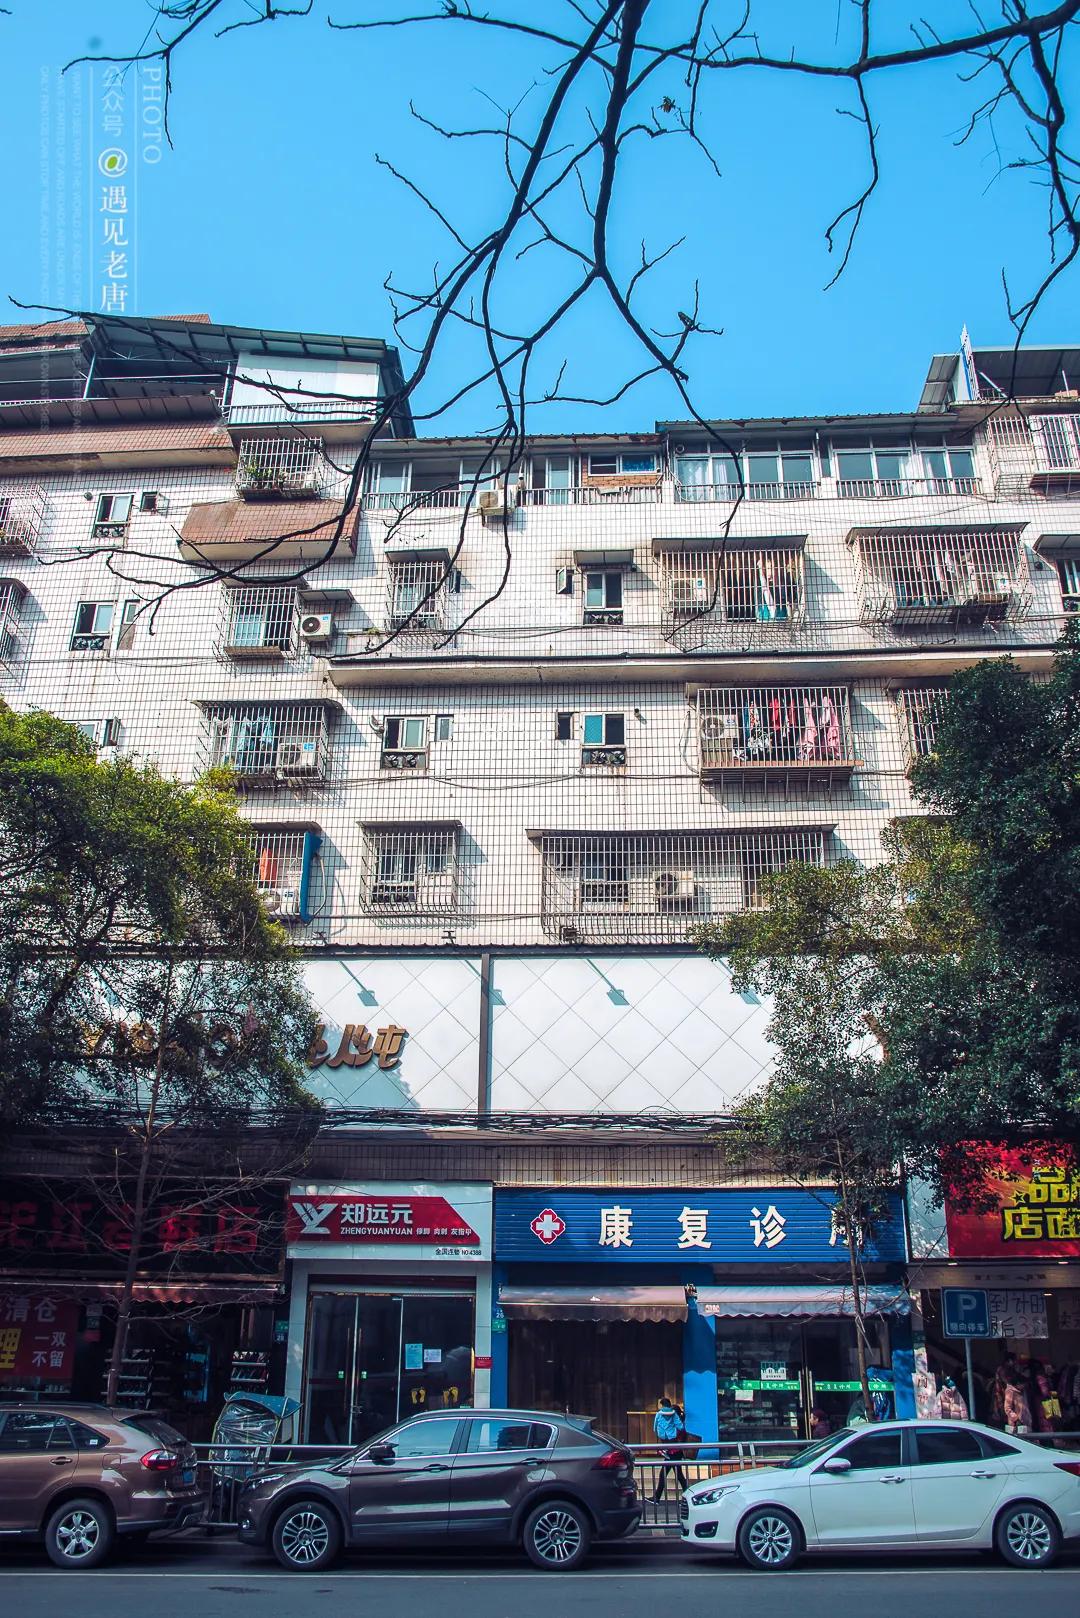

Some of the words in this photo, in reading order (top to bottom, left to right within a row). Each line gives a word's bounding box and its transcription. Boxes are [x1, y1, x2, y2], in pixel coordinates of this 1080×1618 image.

[341, 1203, 413, 1224] 郑远元
[340, 1226, 413, 1236] ZHENGYUANYUAN
[0, 1296, 58, 1323] 清仓
[958, 1294, 977, 1321] P
[34, 1330, 67, 1347] 一双
[31, 1349, 65, 1368] 不留
